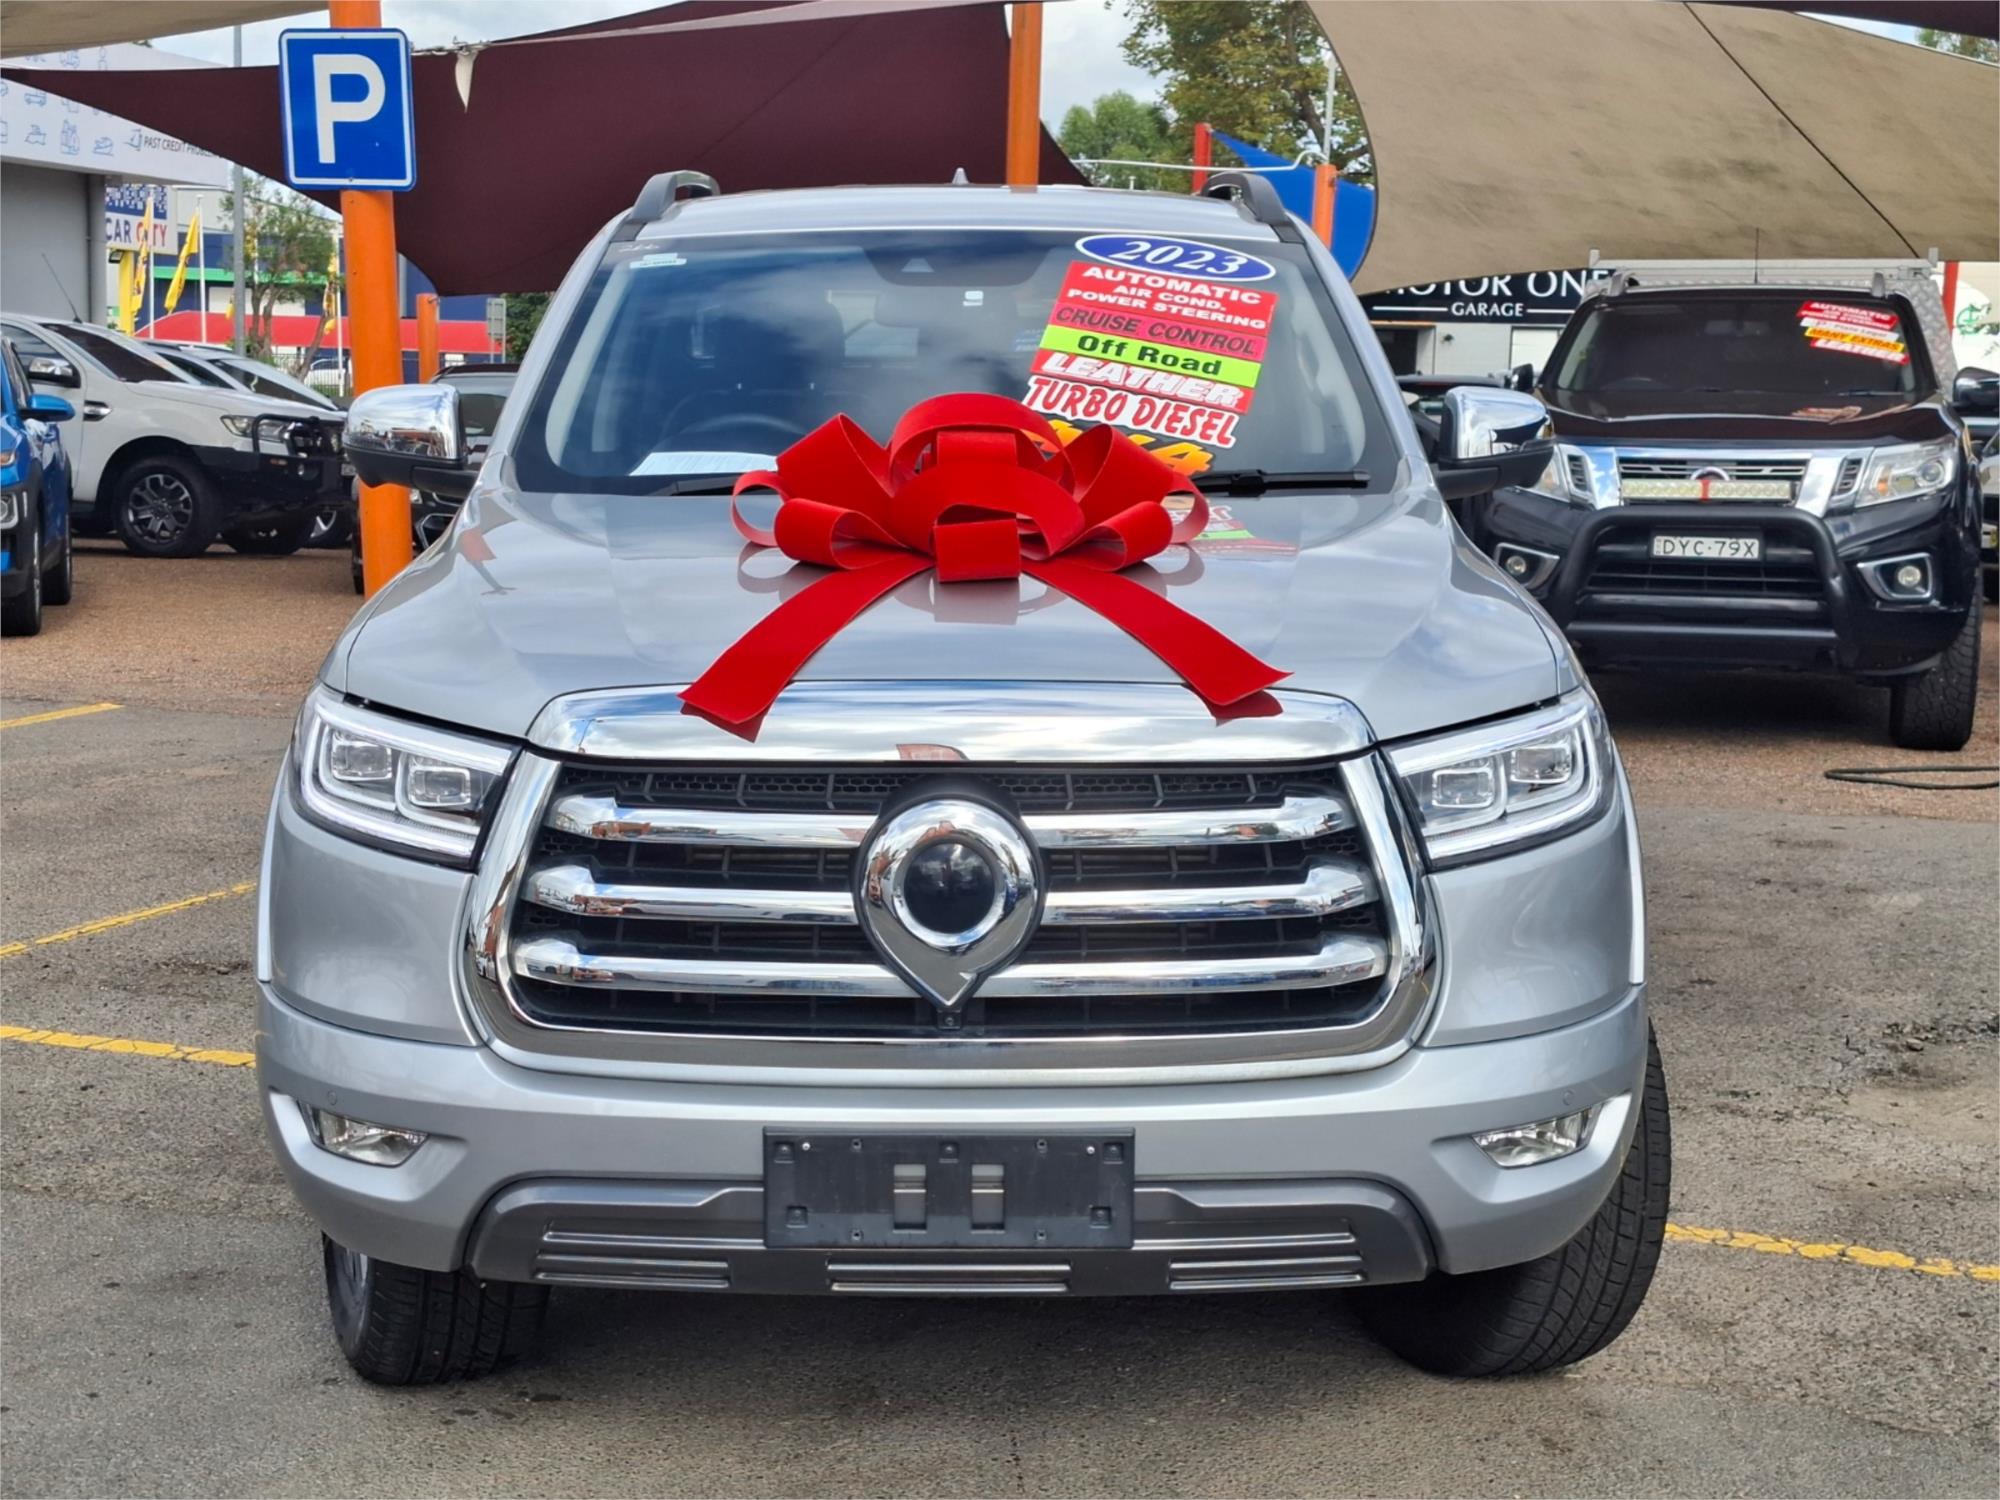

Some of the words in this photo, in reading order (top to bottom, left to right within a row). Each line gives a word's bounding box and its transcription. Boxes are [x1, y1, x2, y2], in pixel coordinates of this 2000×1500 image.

[313, 53, 386, 164] P
[144, 136, 161, 149] PAST
[162, 139, 185, 152] CREDIT
[105, 218, 132, 243] CAR
[136, 221, 167, 247] CTY
[1108, 241, 1249, 274] 2023
[1082, 266, 1262, 305] AUTOMATIC
[1113, 286, 1153, 299] AIR
[1158, 292, 1227, 311] COND.
[1066, 288, 1147, 309] POWER
[1153, 299, 1267, 329] STEERING
[1451, 302, 1524, 317] GARAGE
[1810, 302, 1892, 320] AUTOMATIC
[1056, 307, 1142, 333] CRUISE
[1147, 322, 1257, 355] CONTROL
[1810, 328, 1849, 340] MANY
[1852, 335, 1899, 351] EXTRAS
[1077, 335, 1129, 357] Off
[1137, 346, 1222, 375] Road
[1042, 352, 1245, 407] LEATHER
[1026, 378, 1129, 421] TURBO
[1132, 397, 1235, 446] DIESEL
